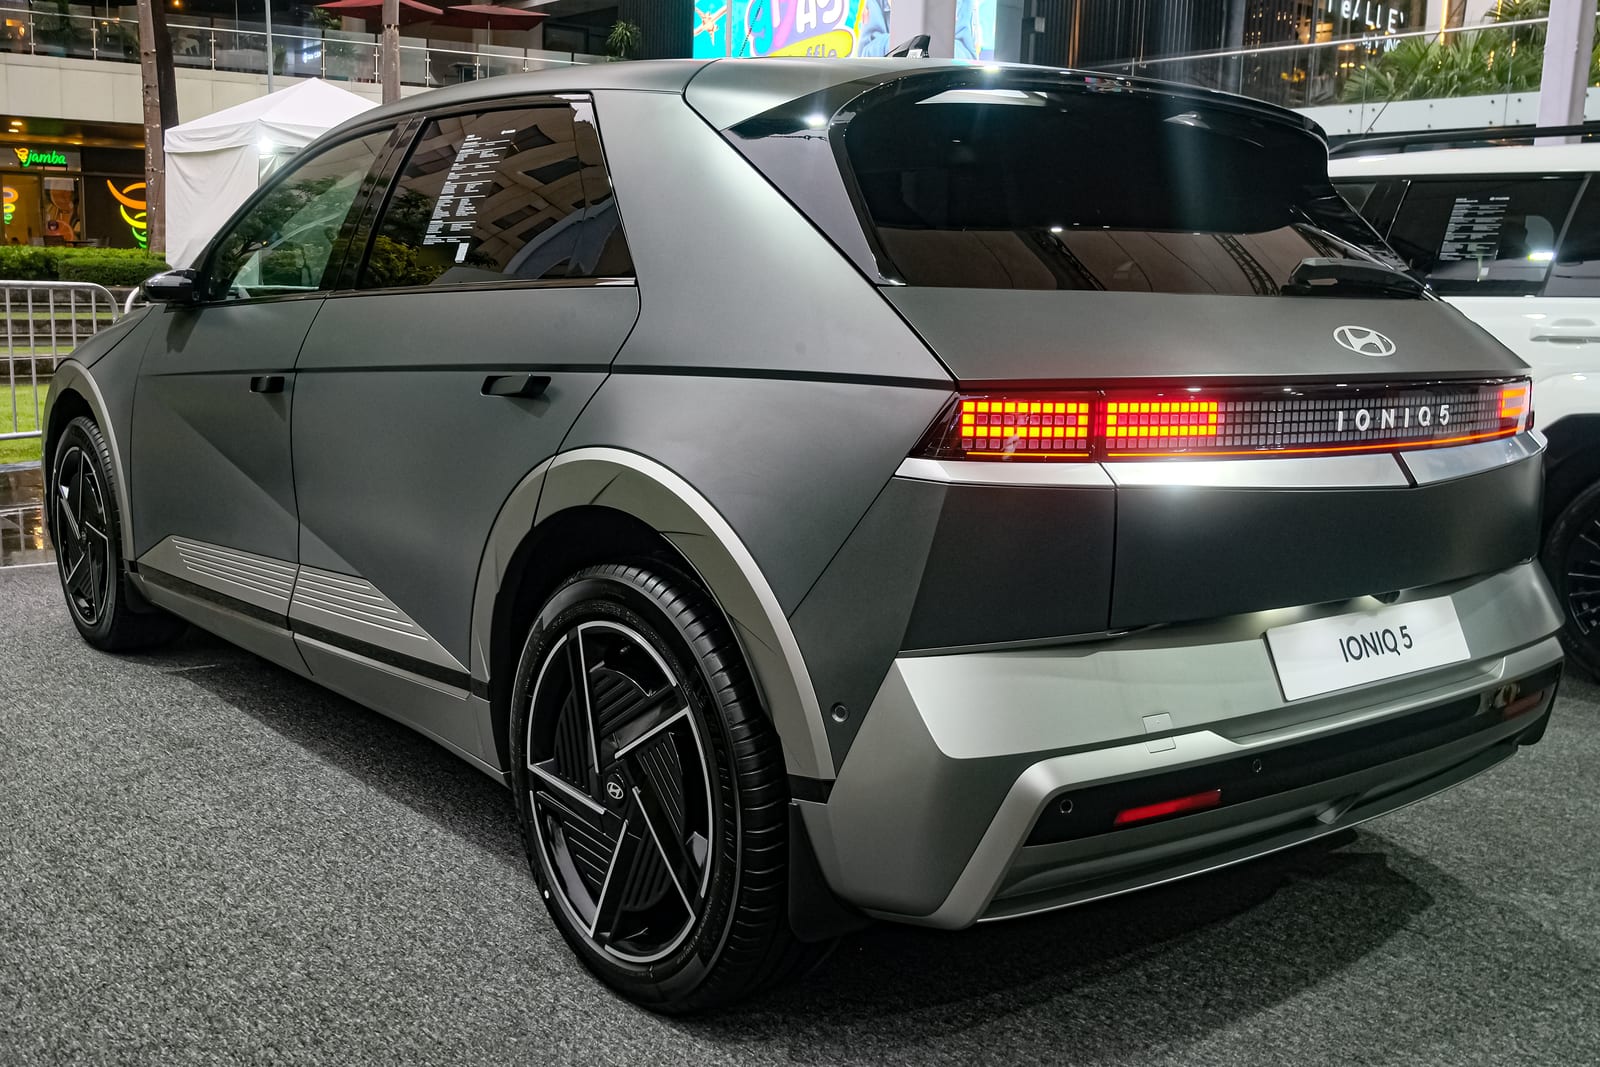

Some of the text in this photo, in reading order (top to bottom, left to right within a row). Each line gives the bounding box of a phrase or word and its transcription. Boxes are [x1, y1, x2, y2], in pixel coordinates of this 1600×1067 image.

[23, 149, 68, 167] jamba
[1338, 625, 1413, 663] IONIQ 5
